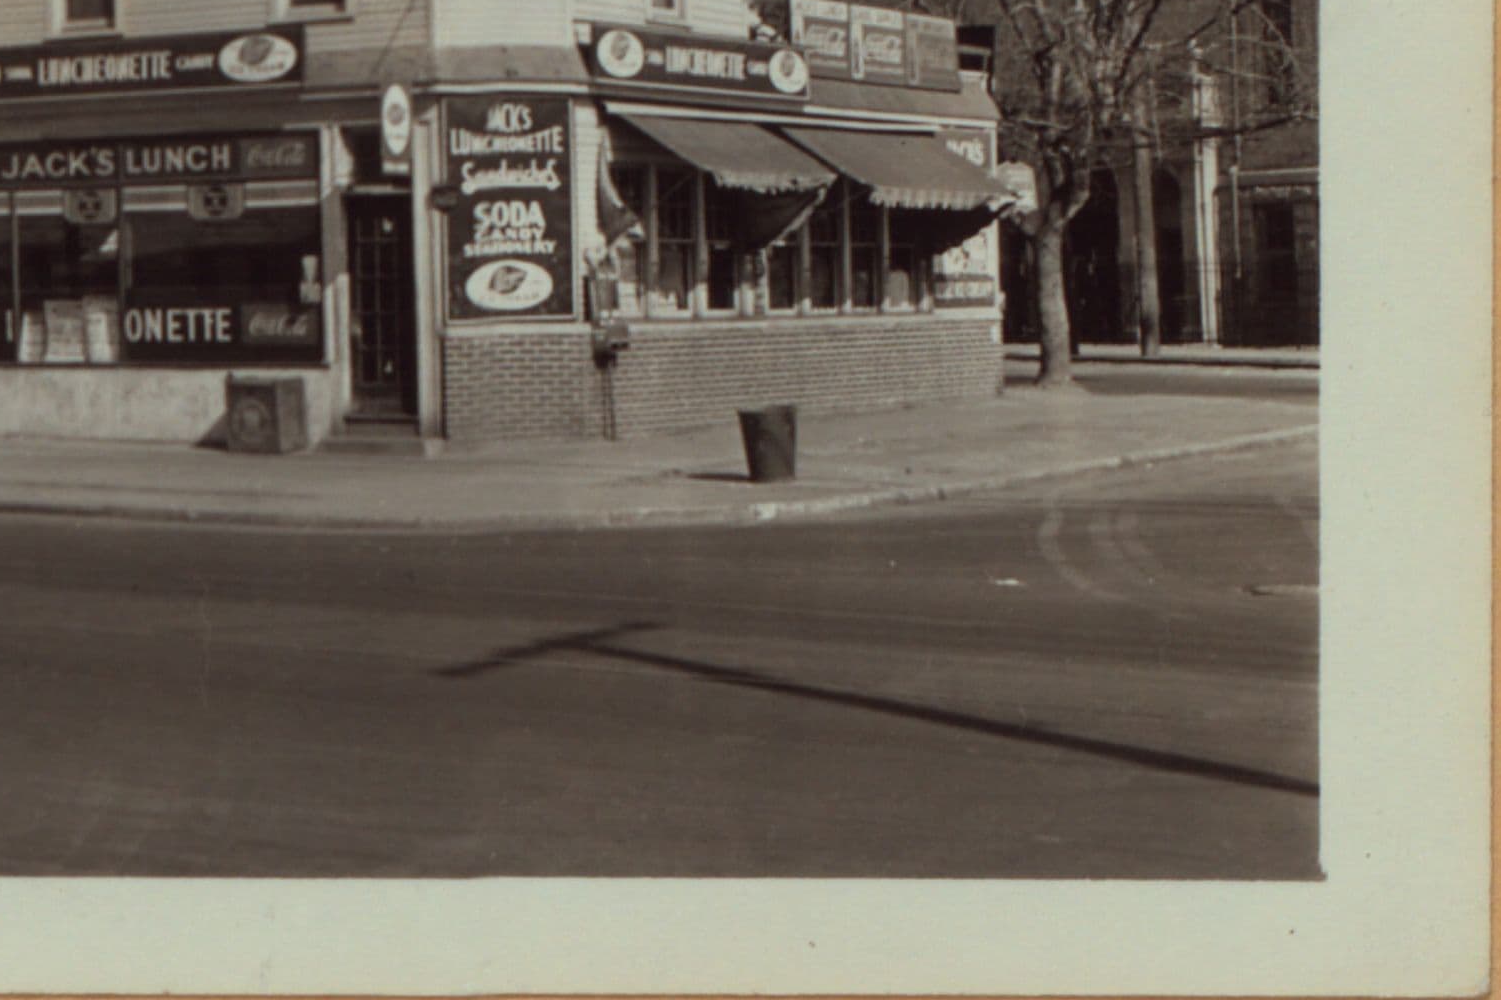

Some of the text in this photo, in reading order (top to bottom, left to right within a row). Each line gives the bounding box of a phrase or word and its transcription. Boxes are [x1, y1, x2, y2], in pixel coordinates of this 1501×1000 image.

[38, 50, 171, 85] LUNCHEONETTE
[450, 125, 564, 155] LUNCHEONETTE
[1, 144, 230, 179] JACK'S LUNCH
[473, 200, 546, 228] SODA
[463, 240, 557, 258] STATIONERY
[473, 227, 544, 242] CANDY
